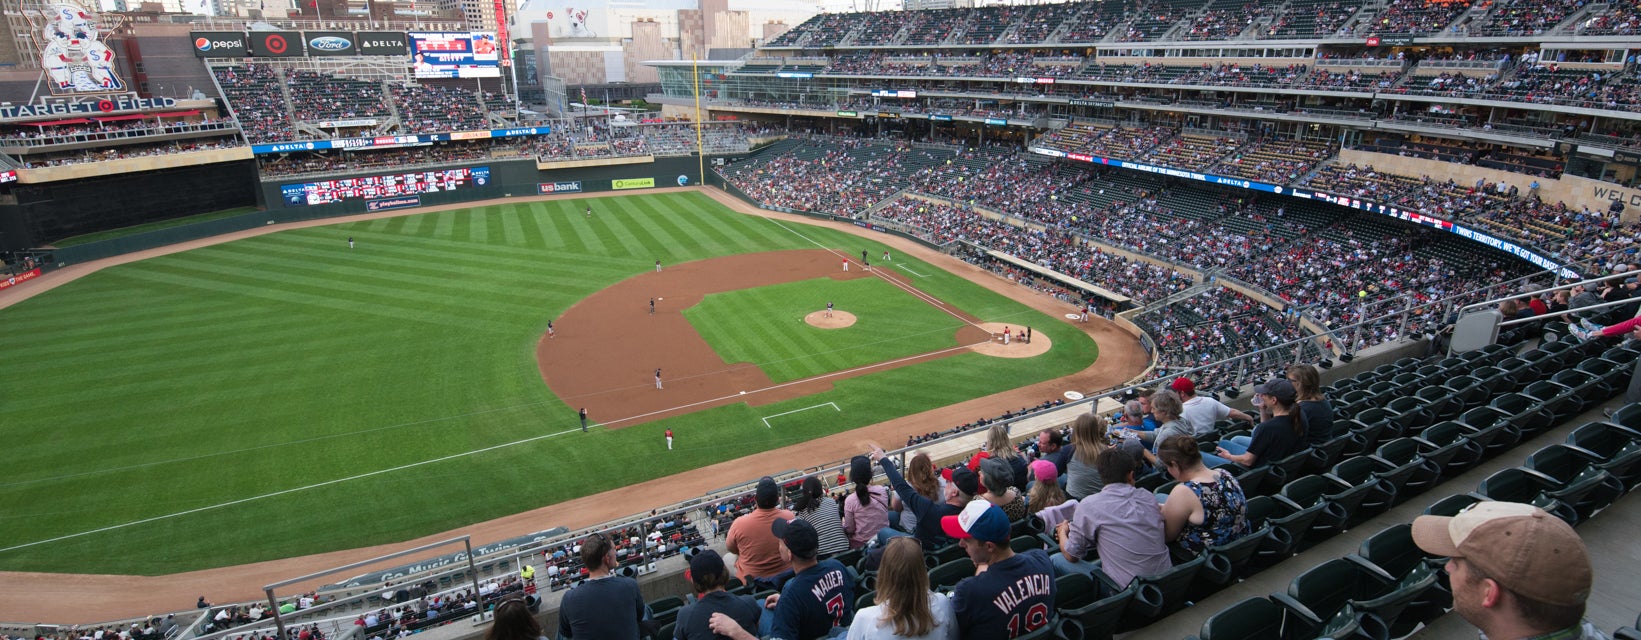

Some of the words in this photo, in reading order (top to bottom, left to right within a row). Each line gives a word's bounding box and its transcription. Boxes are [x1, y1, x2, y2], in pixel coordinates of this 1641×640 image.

[212, 39, 242, 50] pepsi
[318, 39, 342, 48] Ford
[0, 102, 95, 118] TARGET
[119, 97, 176, 111] FIELD
[1222, 178, 1241, 186] DELTA
[1456, 225, 1472, 239] TWINS
[1520, 248, 1530, 260] GOT
[1530, 253, 1543, 266] YOUR
[811, 570, 844, 602] MAUER
[993, 574, 1050, 614] VALENCIA
[826, 592, 845, 627] 7
